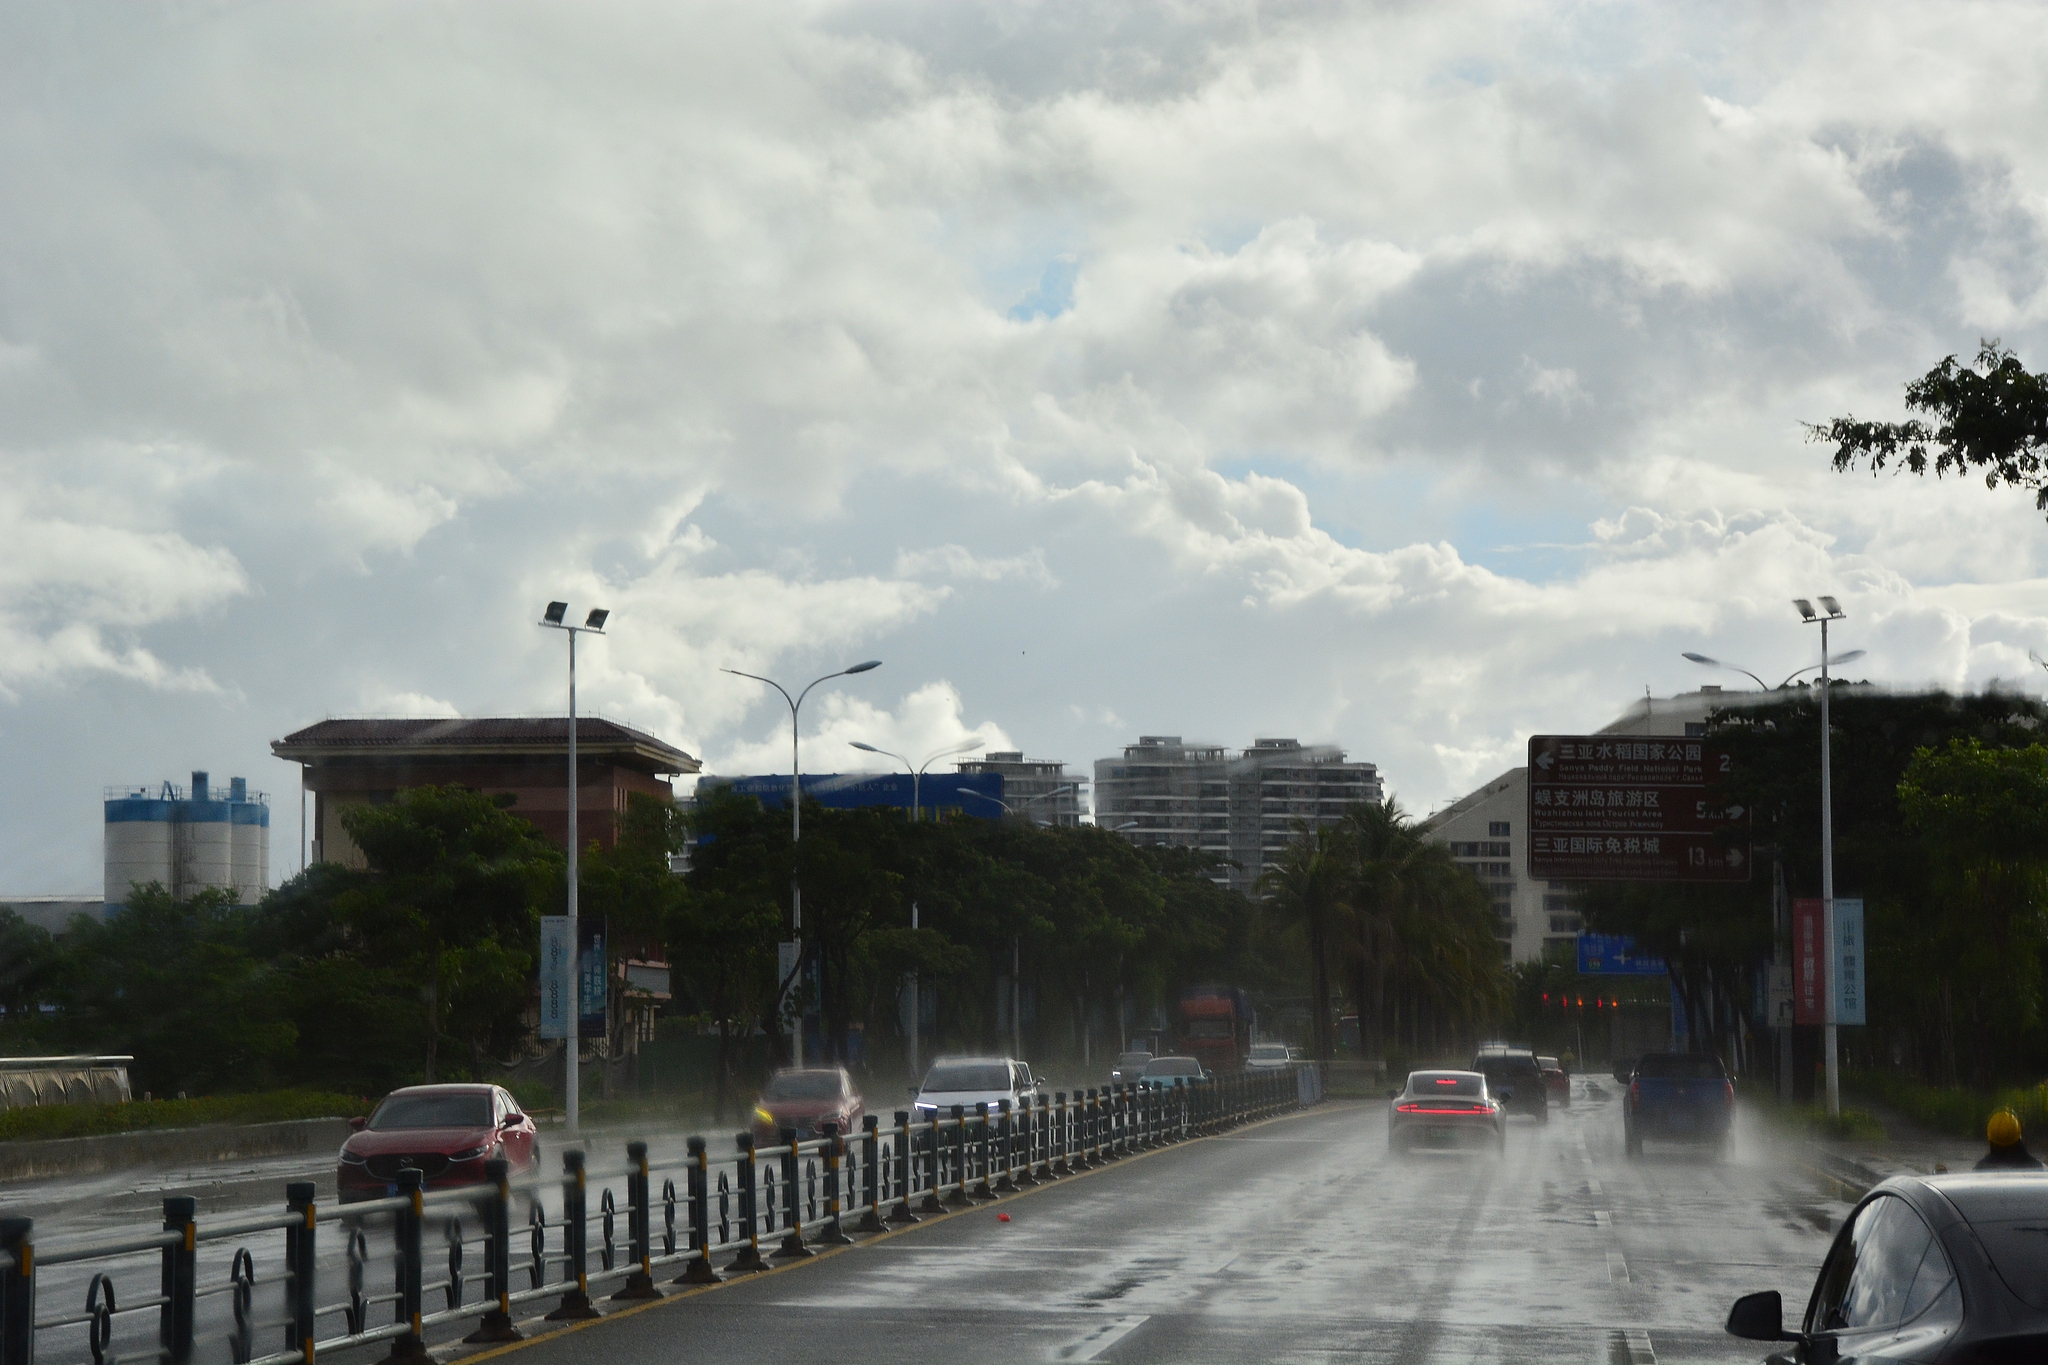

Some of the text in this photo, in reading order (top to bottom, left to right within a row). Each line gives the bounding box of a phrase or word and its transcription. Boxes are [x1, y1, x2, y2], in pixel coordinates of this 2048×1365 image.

[1559, 743, 1702, 761] 三亚水稻国家公园
[1558, 763, 1703, 774] Sanya Paddy Field National Park
[1719, 753, 1731, 772] 2
[1534, 789, 1660, 807] 蜈支洲岛旅游区
[1534, 808, 1663, 818] Wuzhizhou Islet Tourist Area
[1696, 800, 1708, 820] 5
[1534, 837, 1660, 854] 三亚国际免税城
[1688, 847, 1706, 867] 13
